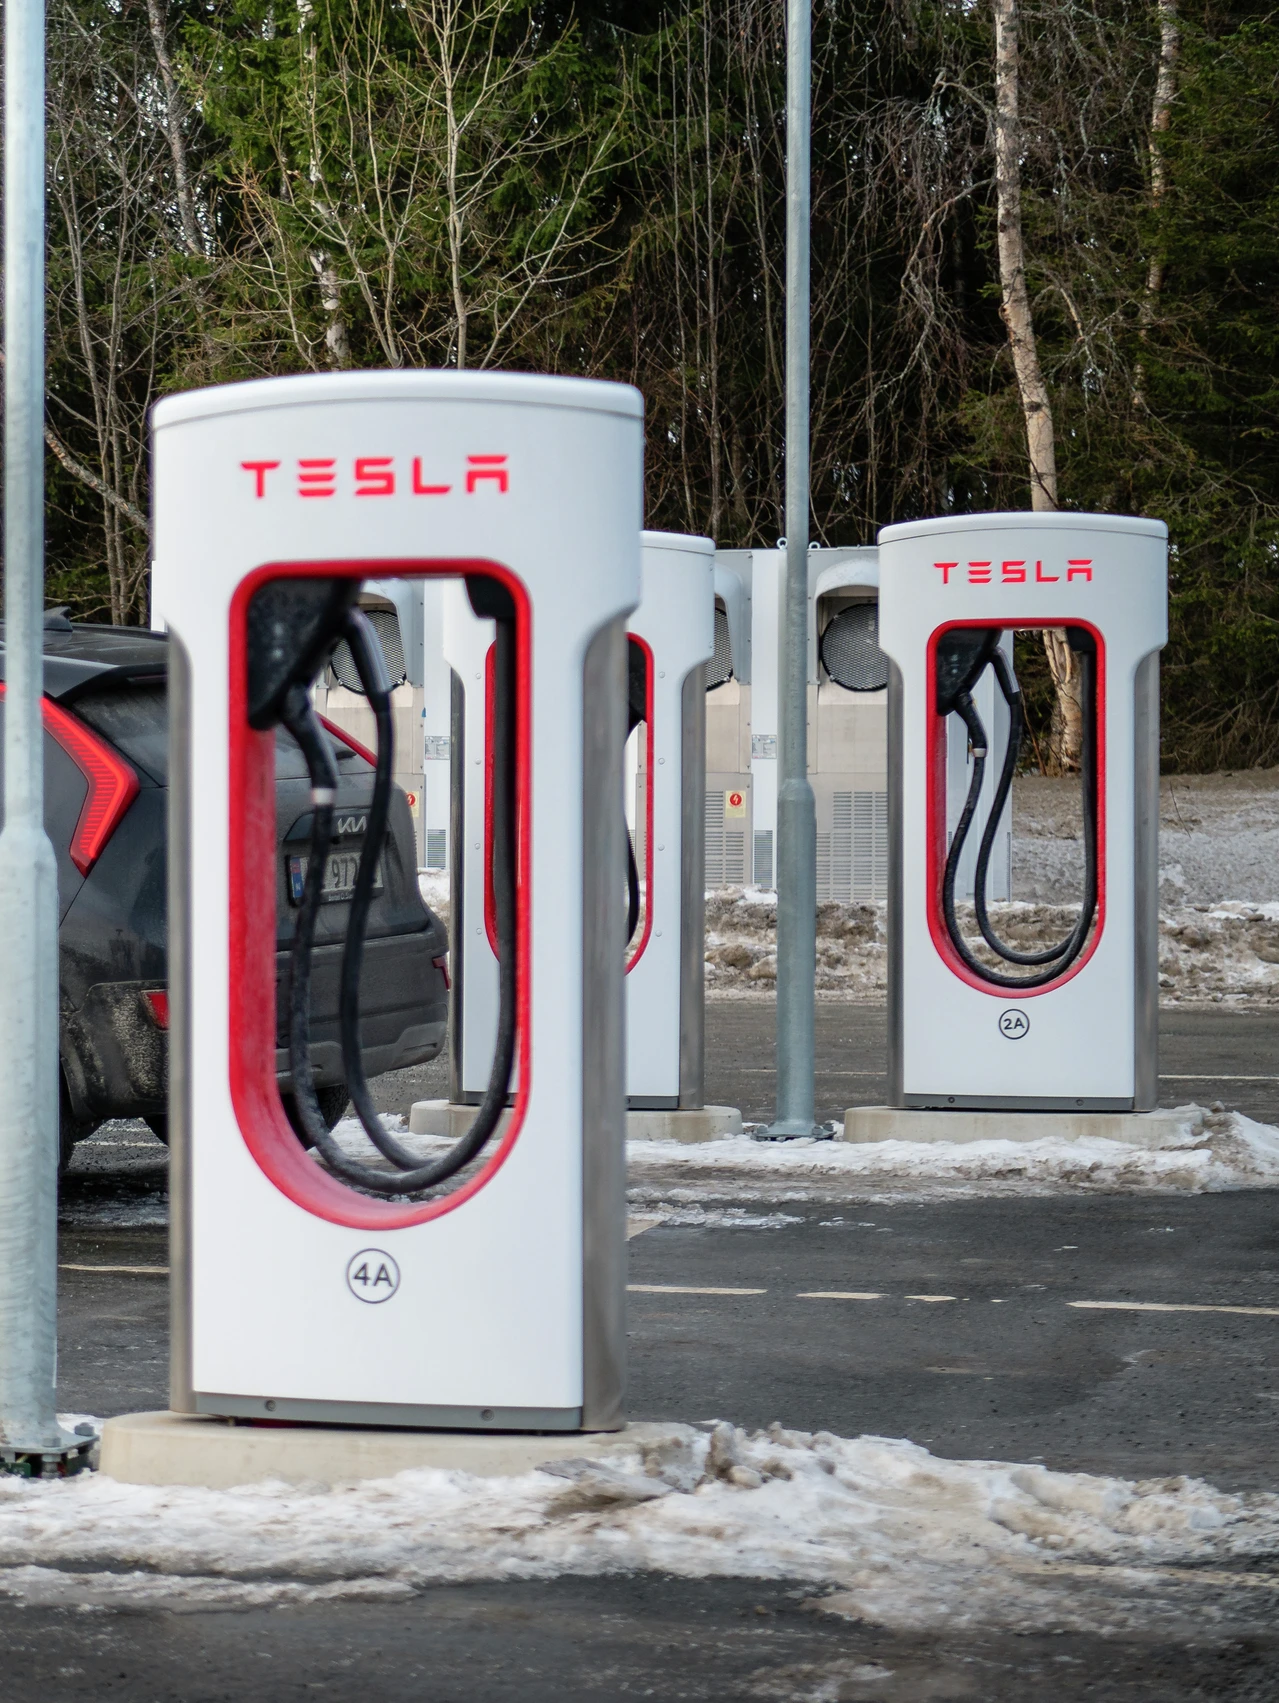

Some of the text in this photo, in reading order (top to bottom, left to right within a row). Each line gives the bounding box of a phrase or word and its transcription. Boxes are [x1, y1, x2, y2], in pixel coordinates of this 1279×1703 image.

[240, 453, 510, 499] TESLA
[933, 558, 1093, 585] TESLA
[1003, 1017, 1025, 1030] 2A
[353, 1262, 393, 1287] 4A
